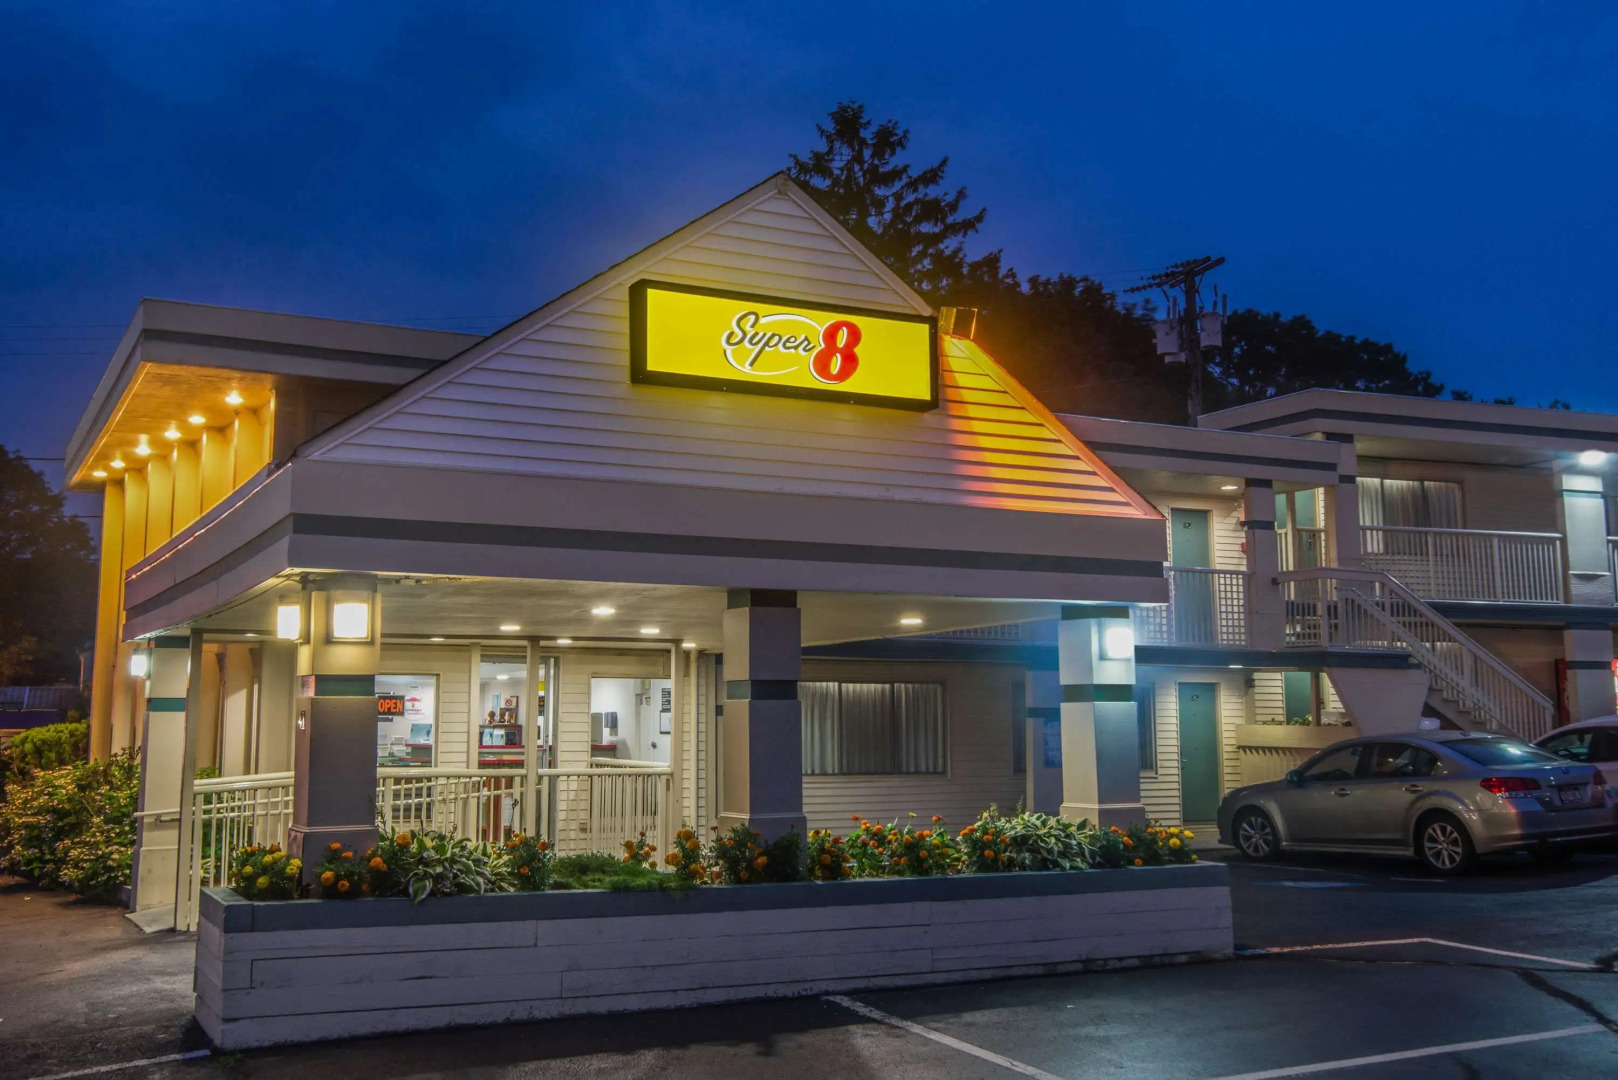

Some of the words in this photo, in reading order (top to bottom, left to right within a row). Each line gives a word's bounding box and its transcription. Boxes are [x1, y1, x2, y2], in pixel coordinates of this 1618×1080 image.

[722, 311, 816, 369] Super
[809, 320, 862, 384] 8
[378, 699, 403, 713] OPEN
